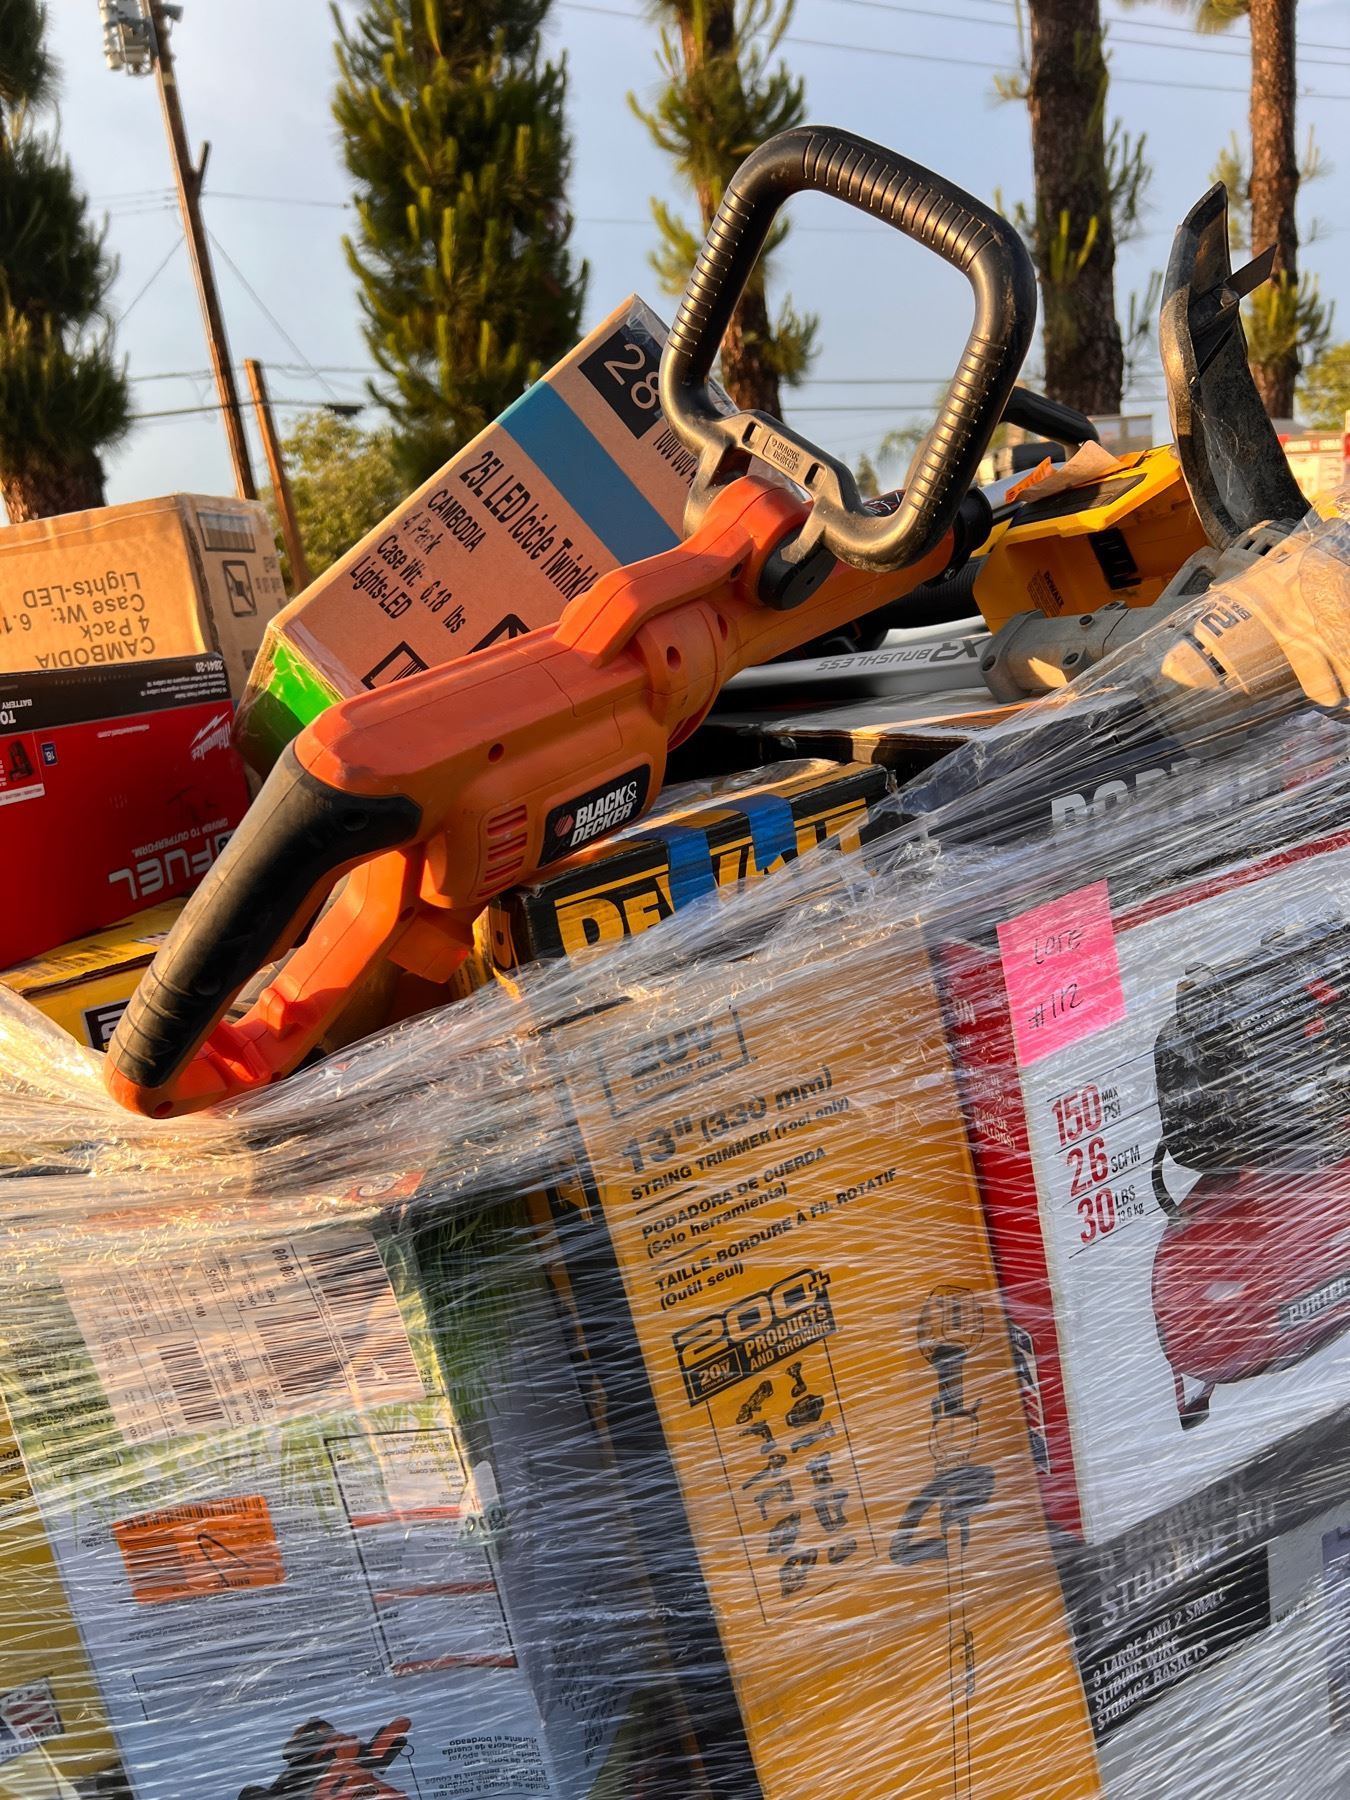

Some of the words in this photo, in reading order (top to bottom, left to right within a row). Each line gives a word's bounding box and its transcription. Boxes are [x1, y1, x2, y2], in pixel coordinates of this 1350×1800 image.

[603, 343, 661, 410] 28
[402, 511, 422, 531] 4
[408, 518, 443, 555] Pack
[427, 489, 487, 553] CAMBODIA
[459, 450, 504, 498] 25L
[482, 474, 531, 524] LED
[507, 503, 557, 561] Icicle
[540, 538, 599, 602] Twinkl
[22, 571, 141, 609] Lights-LED
[92, 594, 145, 615] Case
[350, 555, 413, 620] Lights-LED
[377, 534, 408, 570] Case
[399, 557, 426, 588] Wt:
[420, 580, 452, 613] 6.18
[443, 604, 466, 634] lbs
[0, 613, 32, 635] 6.1
[50, 604, 87, 625] Wt:
[79, 618, 132, 642] Pack
[138, 615, 150, 633] 4
[35, 636, 156, 669] CAMBODIA
[195, 659, 223, 673] 2841-20
[815, 647, 933, 672] BRUSHLESS
[928, 636, 993, 663] XR
[2, 698, 33, 710] BATTERY
[191, 720, 232, 762] Milwaukee
[574, 781, 638, 827] BLACK&
[131, 830, 190, 859] OUTPERFORM.
[190, 826, 201, 839] TO
[569, 804, 633, 848] DECKER
[108, 838, 214, 901] FUEL
[700, 1095, 767, 1143] (330
[775, 1064, 833, 1112] mm)
[1051, 1084, 1104, 1147] 150
[1102, 1086, 1119, 1103] MAX
[1103, 1099, 1122, 1123] PSI
[631, 1165, 692, 1201] STRING
[695, 1130, 771, 1171] TRIMMER
[774, 1118, 811, 1140] (Tool
[815, 1095, 850, 1121] only)
[1066, 1136, 1110, 1197] 2.6
[1110, 1144, 1142, 1174] SCFM
[641, 1189, 734, 1240] PODADORA
[737, 1176, 760, 1197] DE
[763, 1147, 827, 1183] CUERDA
[1076, 1187, 1116, 1244] 30
[1115, 1184, 1137, 1209] LBS
[1133, 1202, 1145, 1216] kg
[647, 1231, 687, 1259] (Solo
[690, 1181, 788, 1238] herramienta)
[654, 1216, 793, 1292] TAILLE-BORDURE
[810, 1200, 832, 1219] FIL
[835, 1168, 898, 1207] ROTATIF
[659, 1280, 703, 1311] (Outil
[707, 1262, 745, 1288] seul)
[673, 1268, 831, 1370] 200+
[744, 1305, 829, 1358] PRODUCTS
[749, 1352, 775, 1372] AND
[777, 1320, 831, 1355] GROWING
[1103, 1636, 1143, 1680] LARGE
[1145, 1617, 1172, 1651] AND
[1174, 1610, 1183, 1629] 2
[1185, 1587, 1227, 1623] SMALL
[1095, 1662, 1146, 1710] SLIDING
[1147, 1634, 1180, 1671] WIRE
[1097, 1672, 1151, 1732] STORAGE
[1153, 1638, 1209, 1687] BASKETS
[441, 1746, 473, 1756] cuerda
[449, 1737, 492, 1747] bordeado
[449, 1752, 479, 1762] apoyar
[494, 1735, 502, 1743] el
[504, 1735, 537, 1744] durante
[449, 1788, 474, 1796] roues
